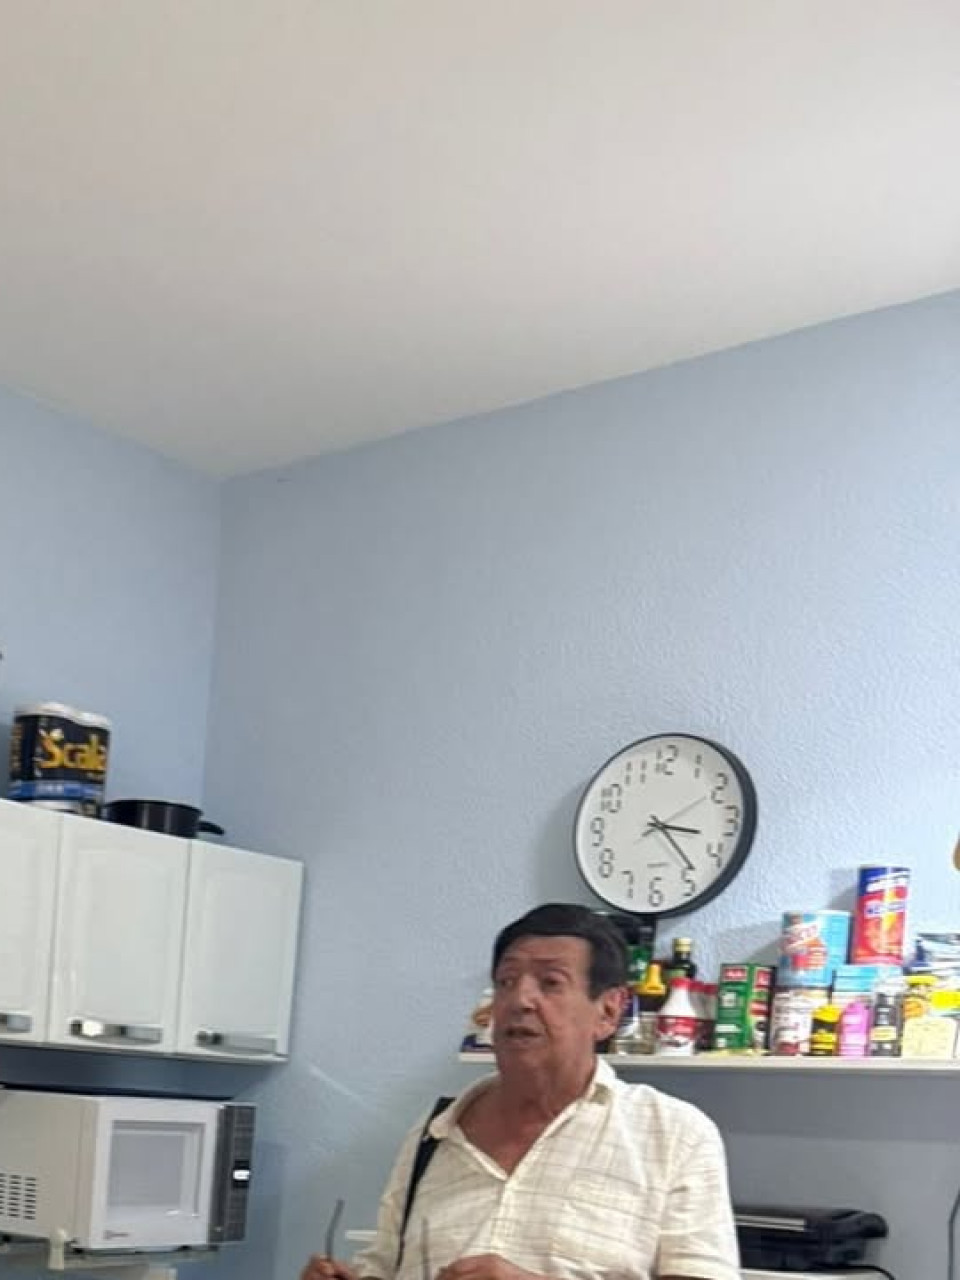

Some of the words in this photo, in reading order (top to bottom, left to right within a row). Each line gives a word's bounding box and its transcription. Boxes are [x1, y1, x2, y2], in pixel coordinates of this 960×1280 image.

[625, 760, 647, 785] 11
[655, 744, 679, 775] 12
[694, 754, 702, 779] 1
[710, 772, 729, 804] 2
[590, 817, 605, 847] 9
[723, 805, 740, 837] 3
[598, 847, 614, 879] 8
[706, 842, 724, 868] 4
[622, 870, 634, 899] 7
[648, 876, 664, 907] 6
